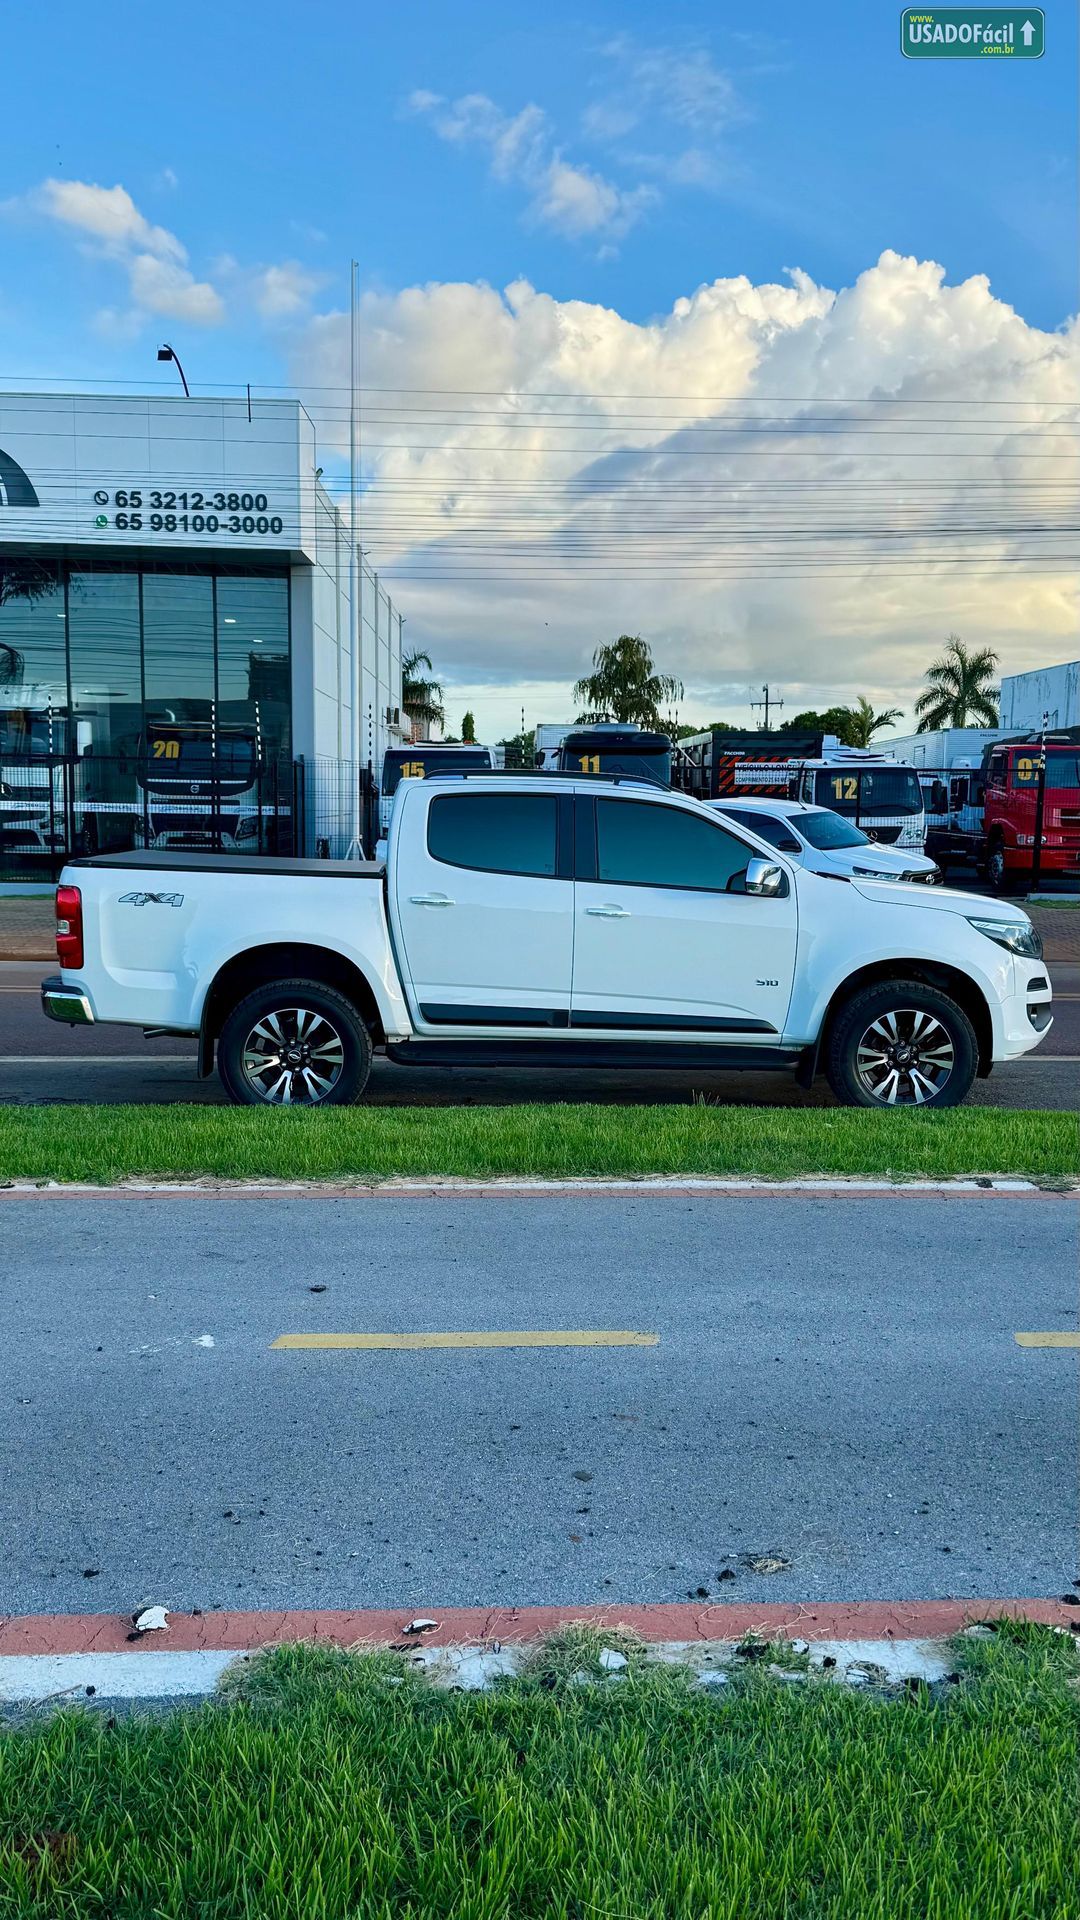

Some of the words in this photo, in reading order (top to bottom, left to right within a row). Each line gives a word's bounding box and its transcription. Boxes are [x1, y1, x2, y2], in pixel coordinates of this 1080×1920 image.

[115, 490, 142, 509] 65
[150, 491, 268, 512] 3212-3800
[115, 513, 142, 531] 65
[150, 514, 283, 534] 98100-3000
[153, 740, 180, 758] 20
[399, 762, 425, 778] 15
[578, 755, 600, 774] 11
[831, 777, 858, 799] 12
